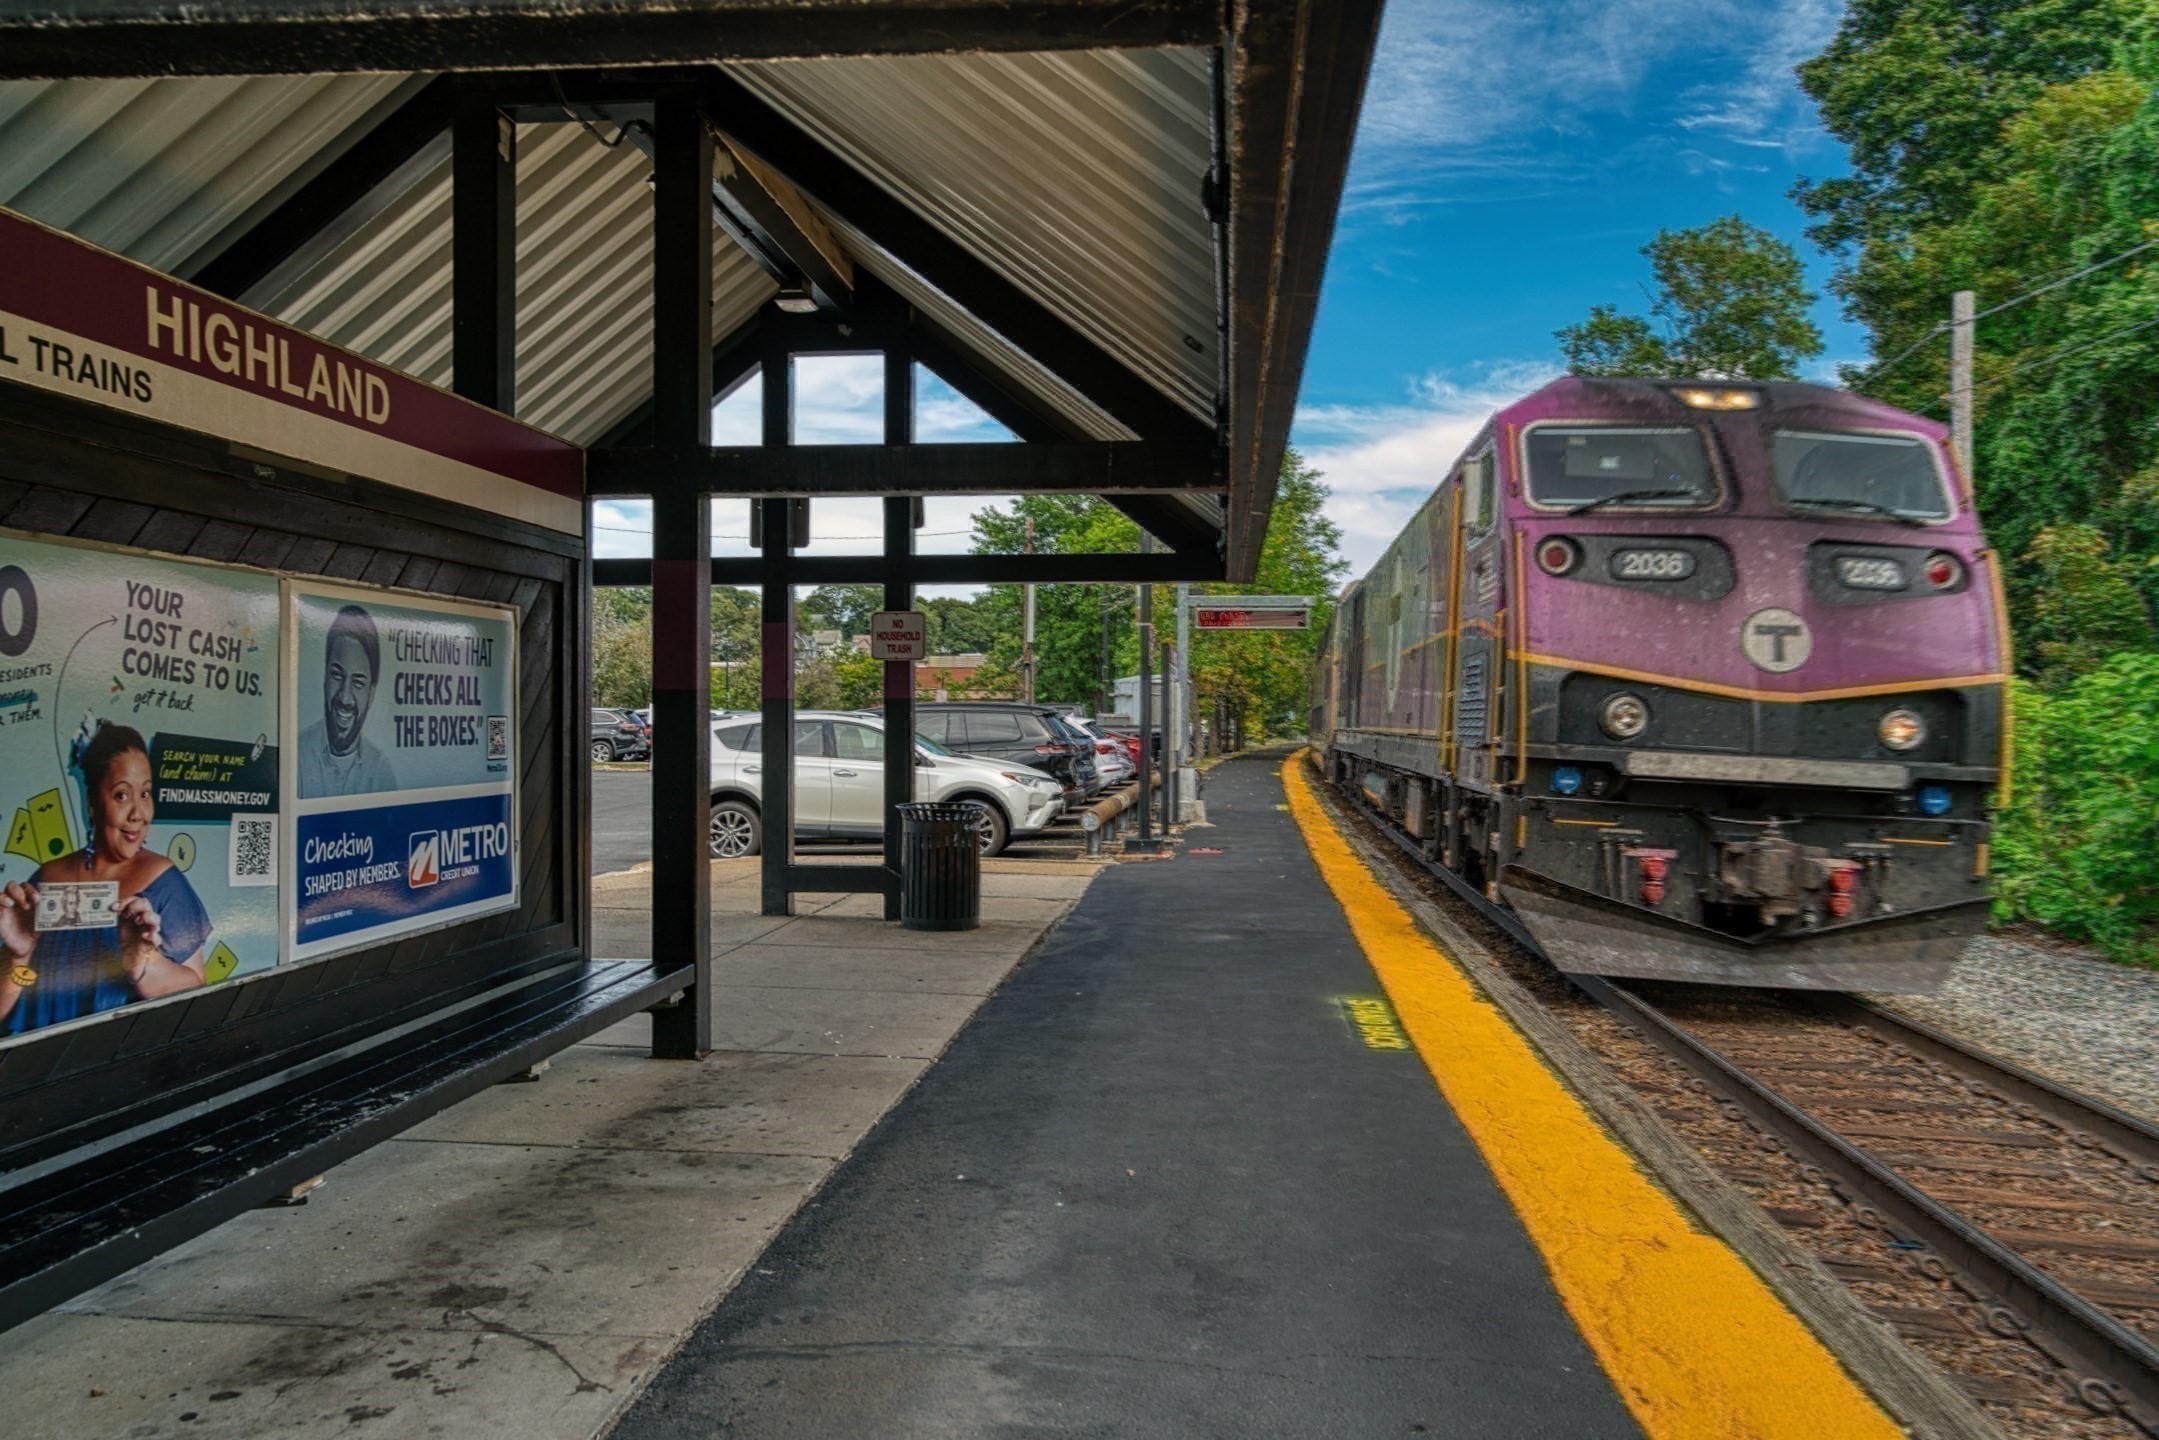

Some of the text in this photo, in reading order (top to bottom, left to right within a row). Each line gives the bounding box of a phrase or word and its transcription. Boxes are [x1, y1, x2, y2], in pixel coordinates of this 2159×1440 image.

[28, 335, 152, 403] TRAINS
[147, 285, 390, 425] HIGHLAND
[1621, 553, 1684, 577] 2036
[126, 580, 184, 619] YOUR
[123, 613, 242, 663] LOST CASH
[876, 631, 921, 641] HOUSEHOLD
[892, 619, 904, 629] NO
[464, 636, 494, 668] THAT
[886, 644, 912, 654] TRASH
[1754, 625, 1801, 662] T
[122, 648, 263, 697] COMES TO US.
[133, 688, 156, 713] get
[157, 690, 168, 708] it
[394, 672, 482, 706] CHECKS ALL
[394, 715, 425, 748] THE
[159, 764, 183, 779] (and
[219, 772, 233, 782] AT
[162, 750, 246, 767] SEARCH YOUR NAME
[158, 788, 271, 805] FINDMASSMONEY.GOV
[304, 832, 374, 864] Checking
[440, 821, 508, 867] METRO
[305, 861, 401, 896] SHAPED BY MEMBERS.
[440, 864, 480, 881] CREDIT UNION
